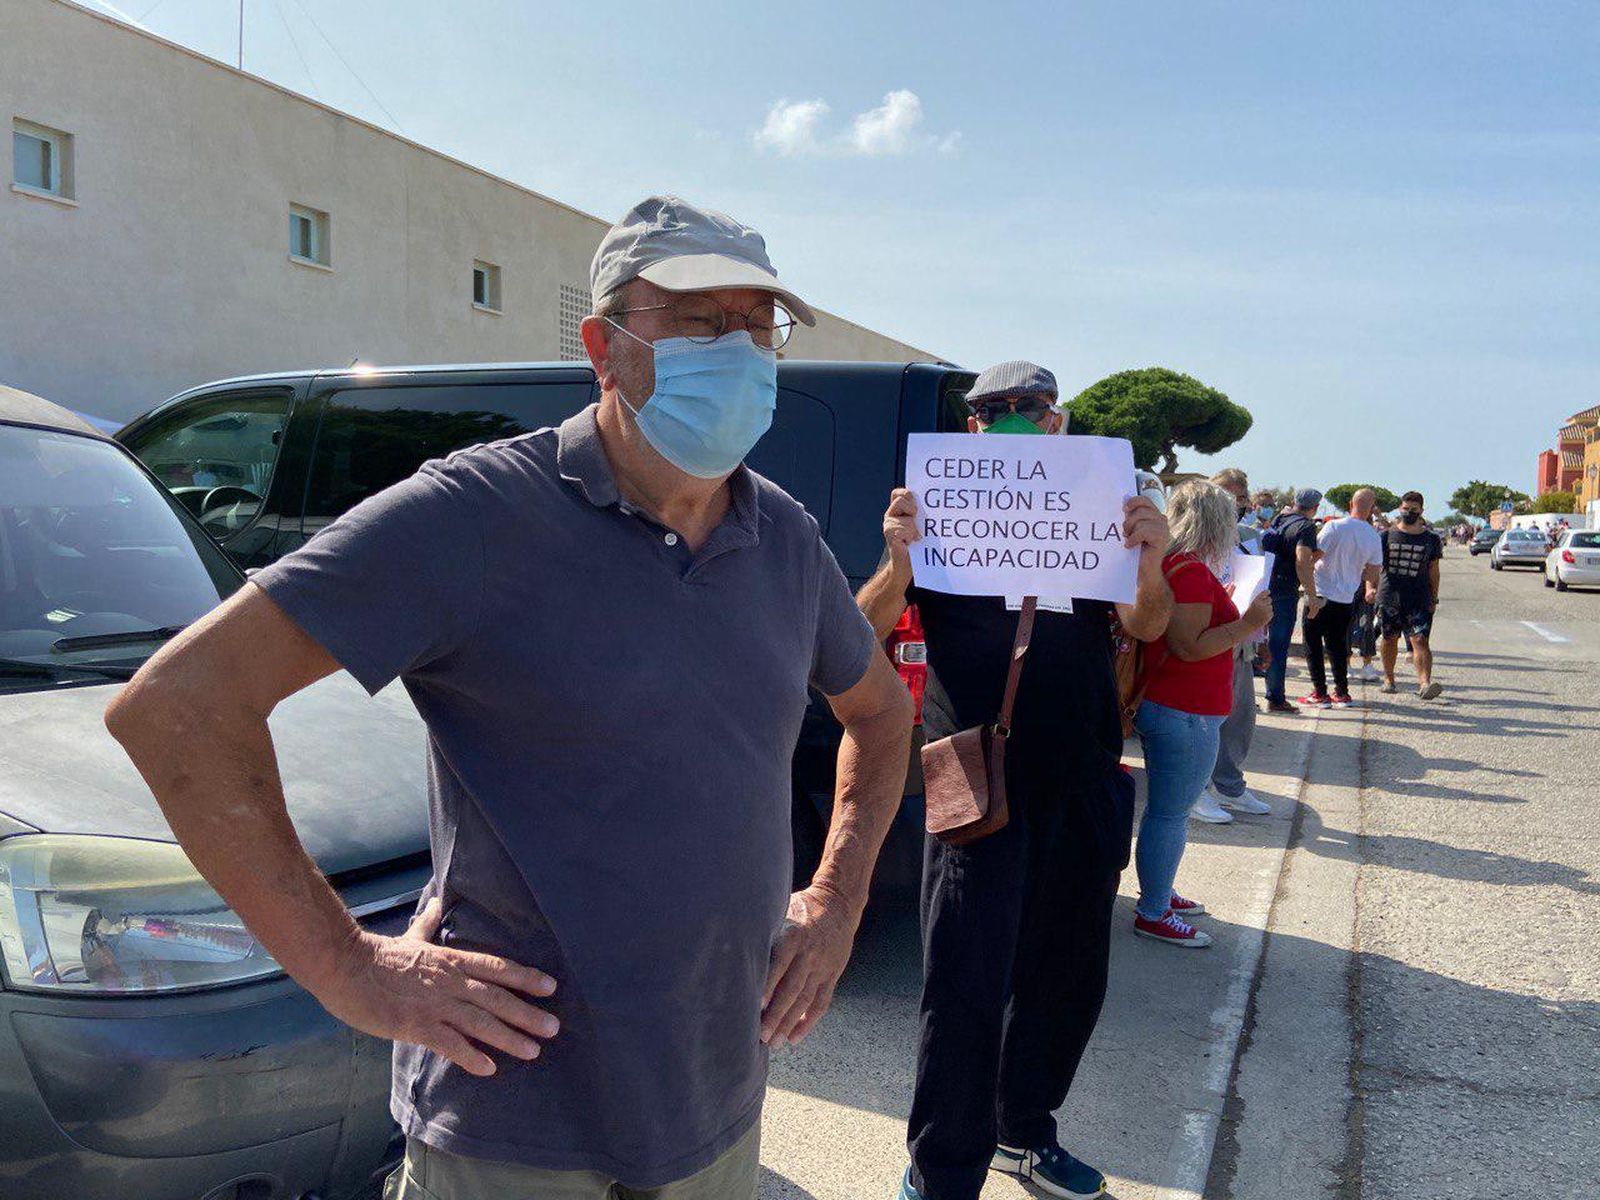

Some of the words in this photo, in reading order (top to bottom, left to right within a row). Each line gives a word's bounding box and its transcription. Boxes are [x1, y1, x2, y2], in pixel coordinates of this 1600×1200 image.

[925, 457, 1005, 480] CEDER
[1016, 460, 1047, 480] LA
[924, 485, 1032, 511] GESTIÓN
[1044, 491, 1071, 512] ES
[924, 518, 1080, 541] RECONOCER
[1090, 522, 1121, 542] LA
[924, 547, 1100, 571] INCAPACIDAD
